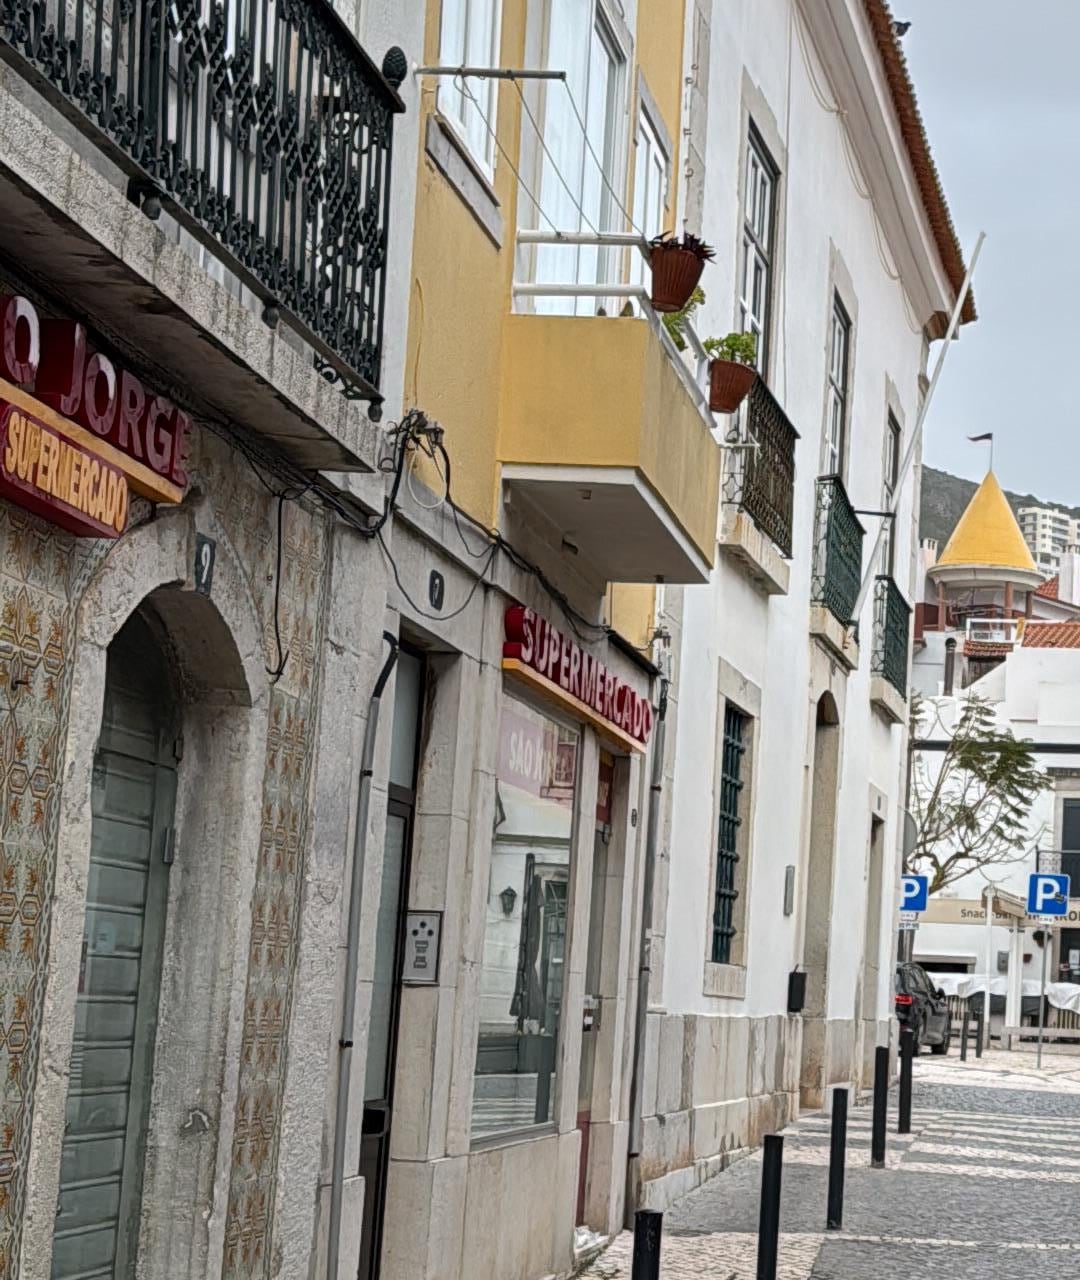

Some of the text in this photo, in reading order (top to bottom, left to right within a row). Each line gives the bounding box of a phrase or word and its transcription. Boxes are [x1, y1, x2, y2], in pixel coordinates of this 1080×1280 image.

[61, 322, 190, 488] JORGE
[4, 410, 129, 533] SUPERMERCADO
[200, 542, 211, 584] 9
[520, 606, 654, 744] SUPERMERCADO
[901, 878, 920, 907] P
[1035, 877, 1060, 911] P
